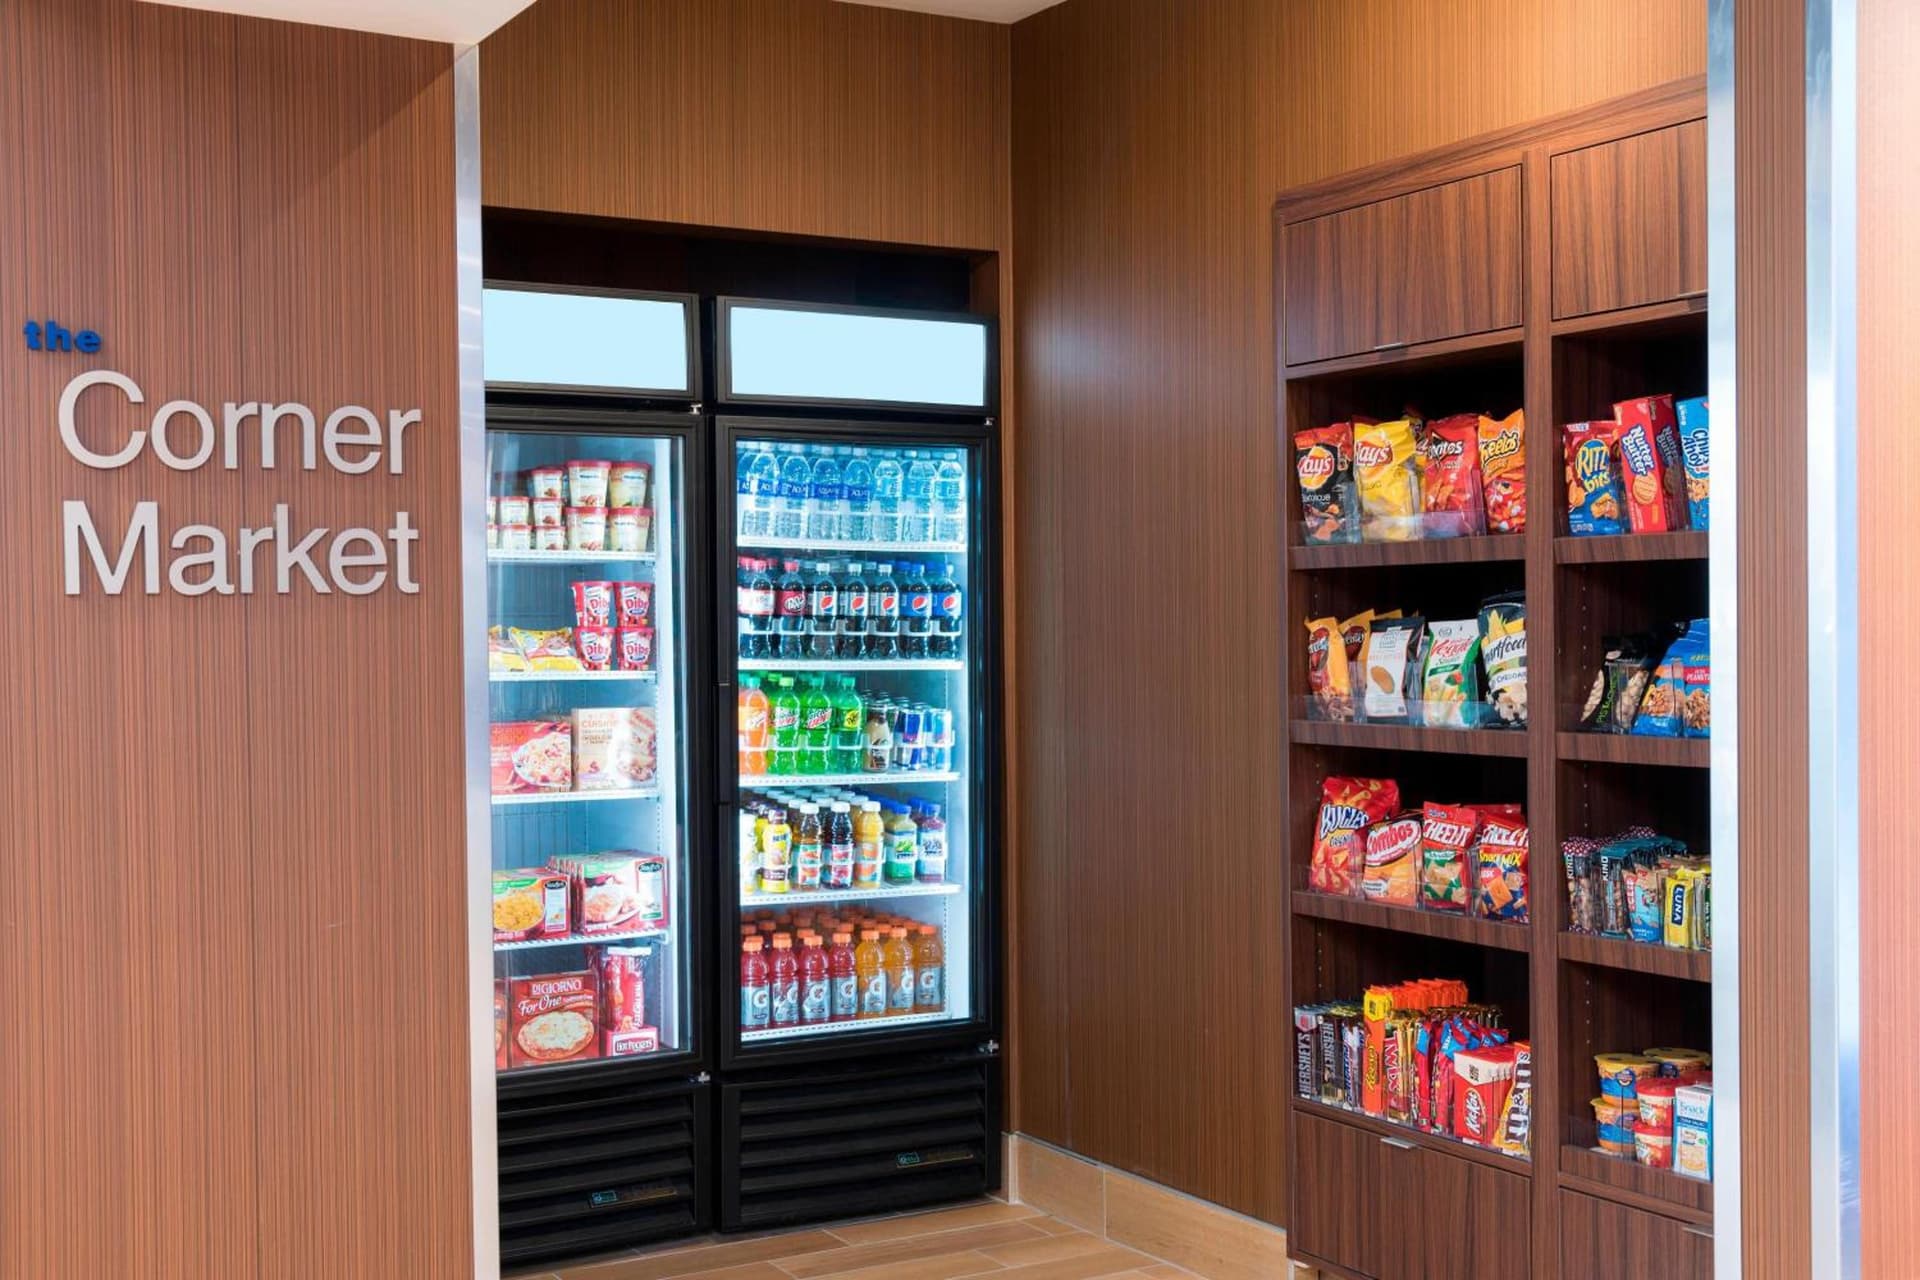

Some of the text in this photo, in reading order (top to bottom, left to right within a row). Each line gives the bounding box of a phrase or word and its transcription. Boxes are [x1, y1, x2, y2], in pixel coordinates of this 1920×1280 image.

[24, 321, 101, 353] the
[58, 369, 422, 474] Corner
[1577, 446, 1609, 479] RITZ
[1622, 433, 1647, 475] Butter
[1630, 425, 1654, 470] Nutter
[62, 500, 420, 595] Market
[1567, 853, 1575, 879] KIND
[1601, 855, 1609, 882] KIND
[1673, 887, 1683, 921] LUNA
[518, 1000, 539, 1016] For
[540, 994, 562, 1010] One
